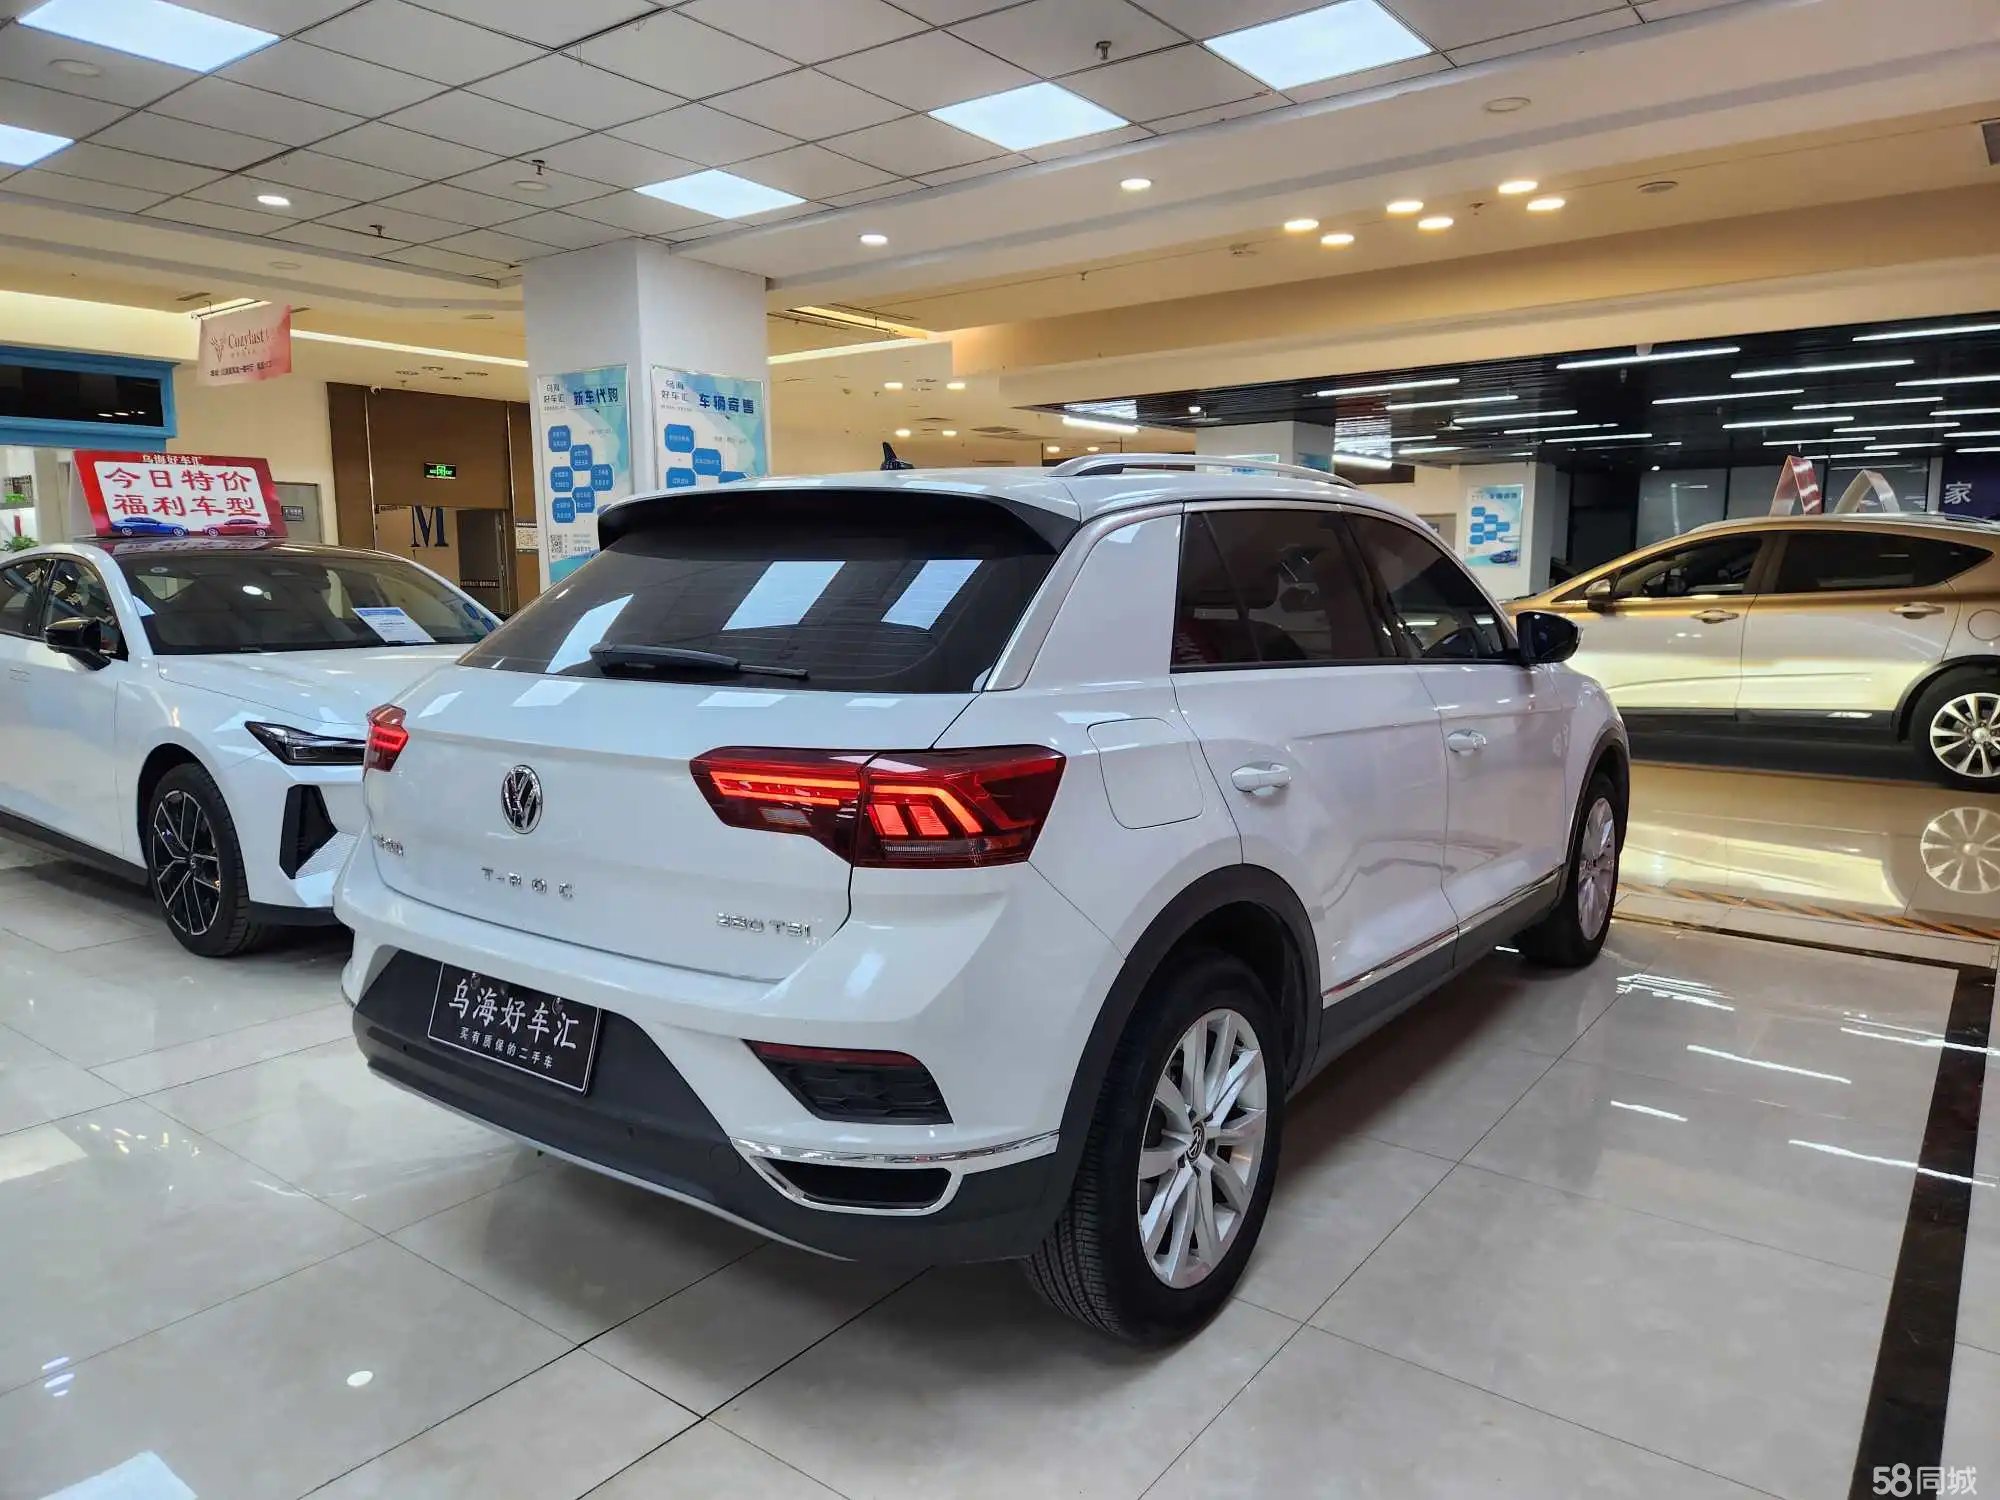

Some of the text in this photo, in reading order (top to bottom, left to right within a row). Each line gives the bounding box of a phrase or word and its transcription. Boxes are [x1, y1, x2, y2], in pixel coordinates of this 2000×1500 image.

[573, 387, 619, 406] 新车代购
[104, 467, 252, 493] 今日特价
[1944, 481, 1971, 504] 家
[112, 493, 262, 518] 福利车型
[448, 978, 580, 1049] 乌海好车汇
[459, 1026, 554, 1069] 买有质保的二手车
